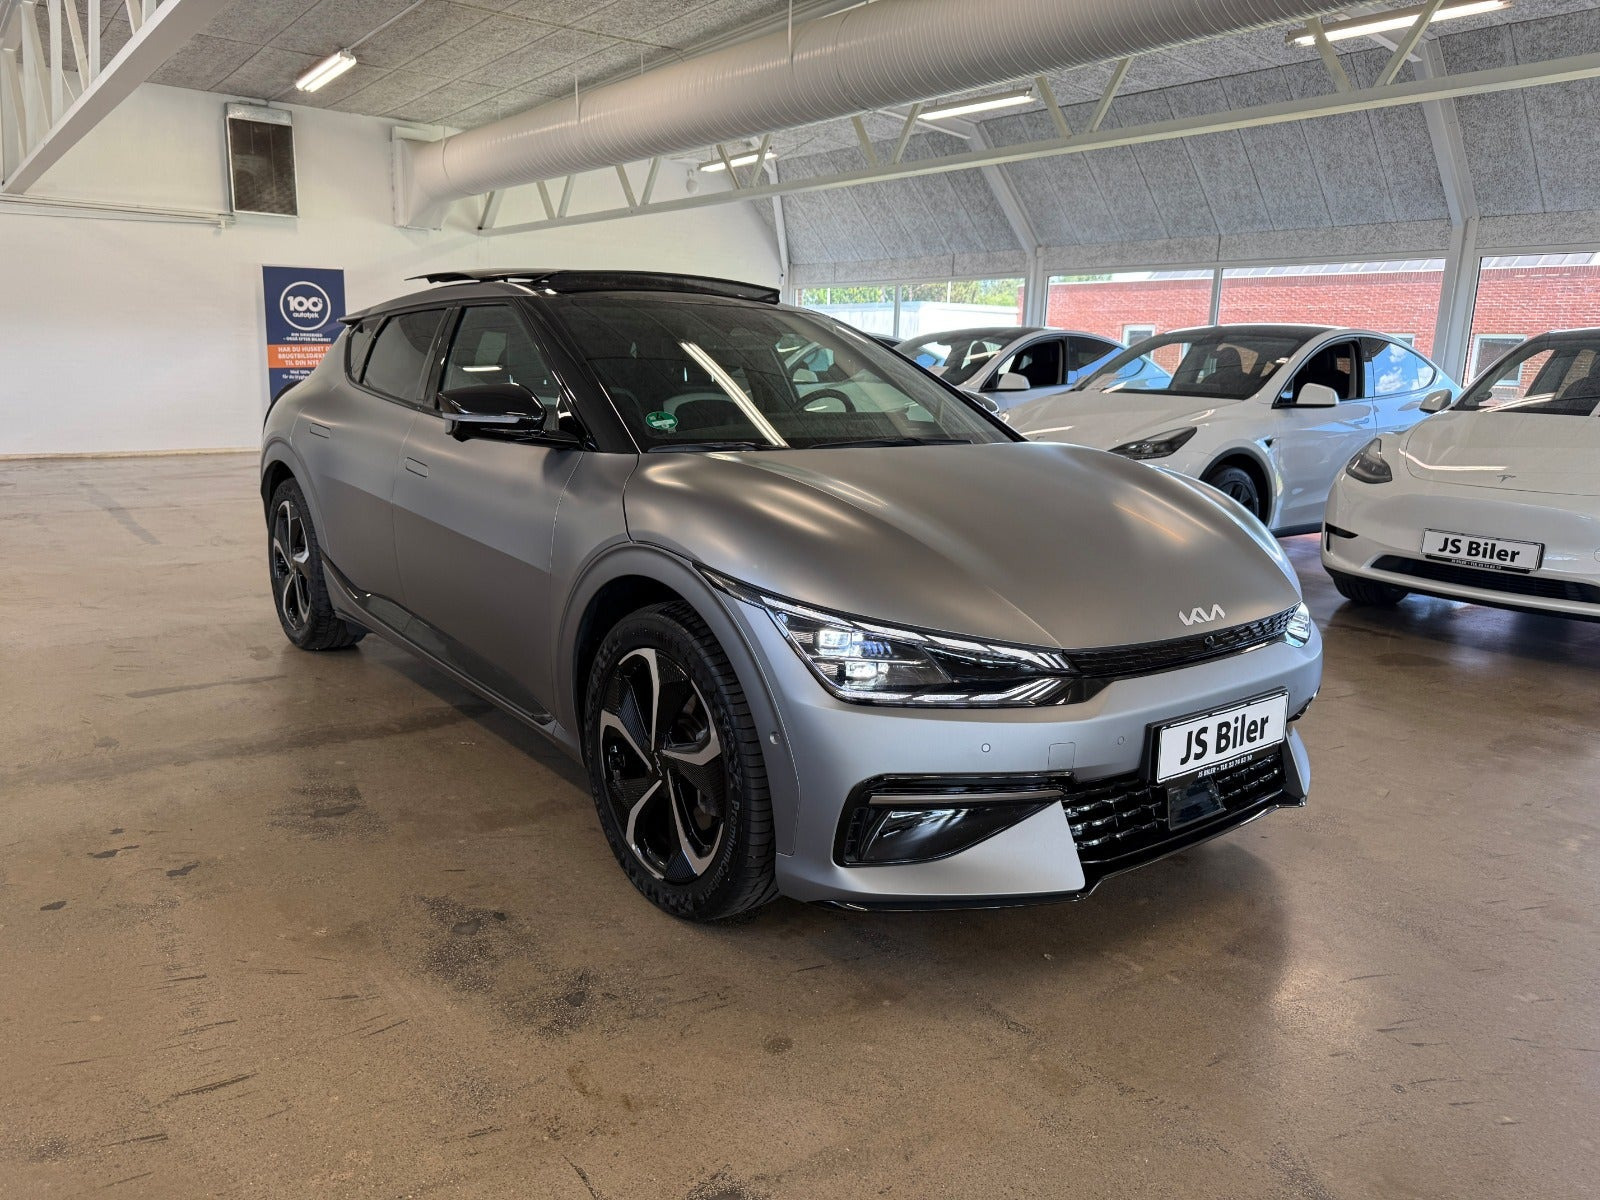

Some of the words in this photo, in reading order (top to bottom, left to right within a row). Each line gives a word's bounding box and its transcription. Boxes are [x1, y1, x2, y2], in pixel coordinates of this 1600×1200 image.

[1438, 537, 1462, 555] JS
[1467, 541, 1520, 563] Biler
[1180, 726, 1209, 766] JS
[1215, 713, 1270, 755] Biler
